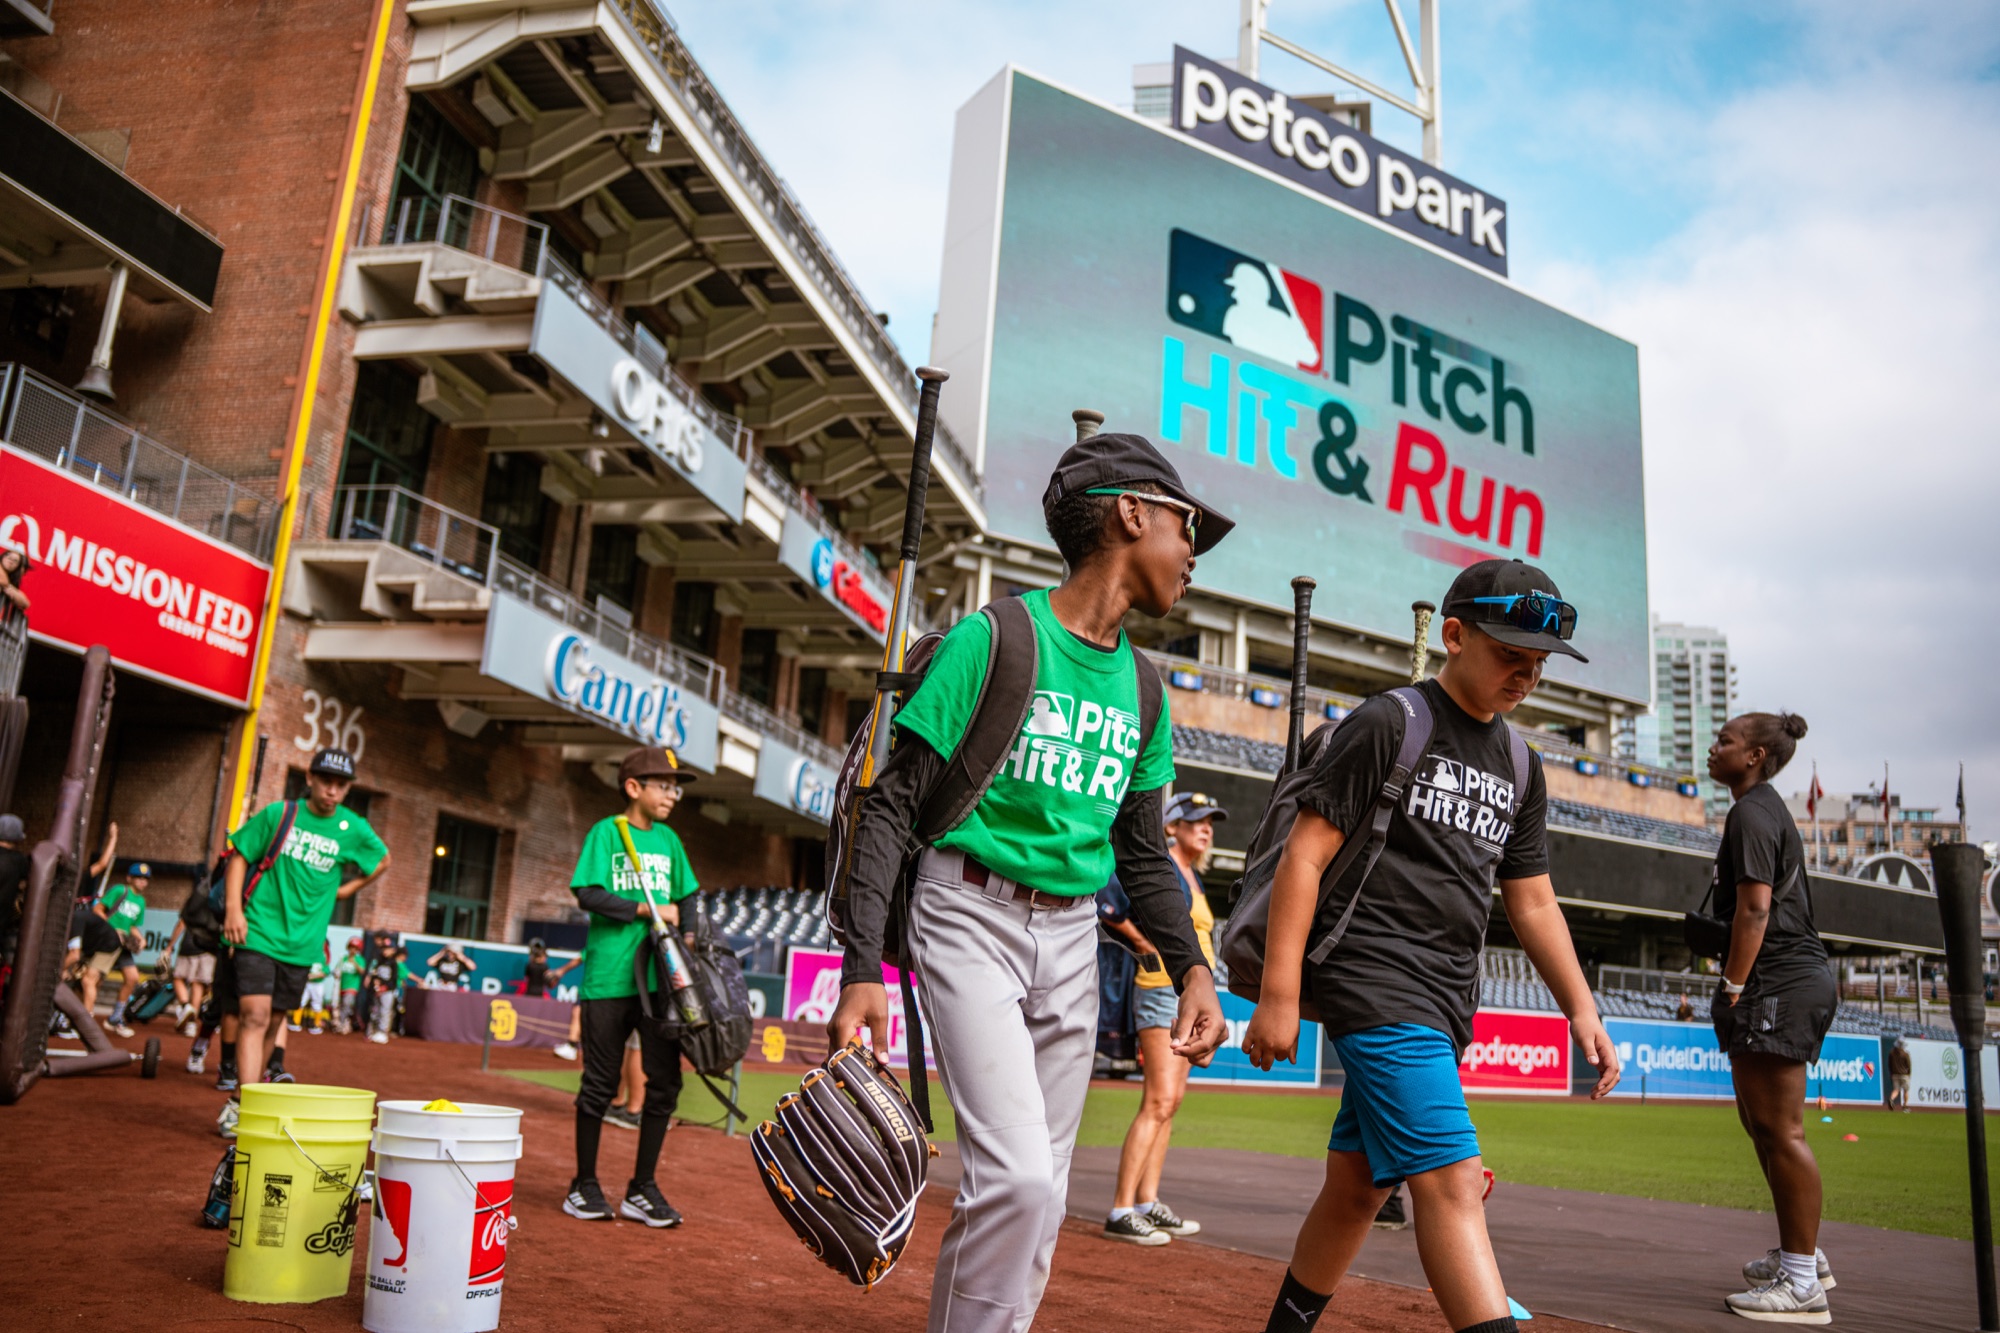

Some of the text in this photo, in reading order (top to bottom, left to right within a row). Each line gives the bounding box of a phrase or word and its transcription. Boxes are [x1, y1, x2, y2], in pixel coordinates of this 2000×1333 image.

[1181, 62, 1505, 256] petco park
[1333, 291, 1536, 456] Pitch
[1161, 335, 1545, 559] Hit & Run
[45, 528, 253, 640] MISSION FED
[158, 611, 249, 658] CREDIT UNION
[548, 632, 689, 751] Canel's
[294, 689, 365, 764] 336
[1074, 700, 1141, 759] Pitc
[840, 717, 873, 811] EAST
[1061, 749, 1084, 794] &
[1408, 784, 1452, 826] Hit
[1454, 799, 1470, 832] &
[300, 830, 340, 856] Pitch
[655, 872, 671, 893] Ru
[1461, 1035, 1560, 1075] apdragon
[1806, 1055, 1865, 1083] thwest
[864, 1081, 914, 1142] marucci
[1918, 1086, 1967, 1103] CYMBIOT
